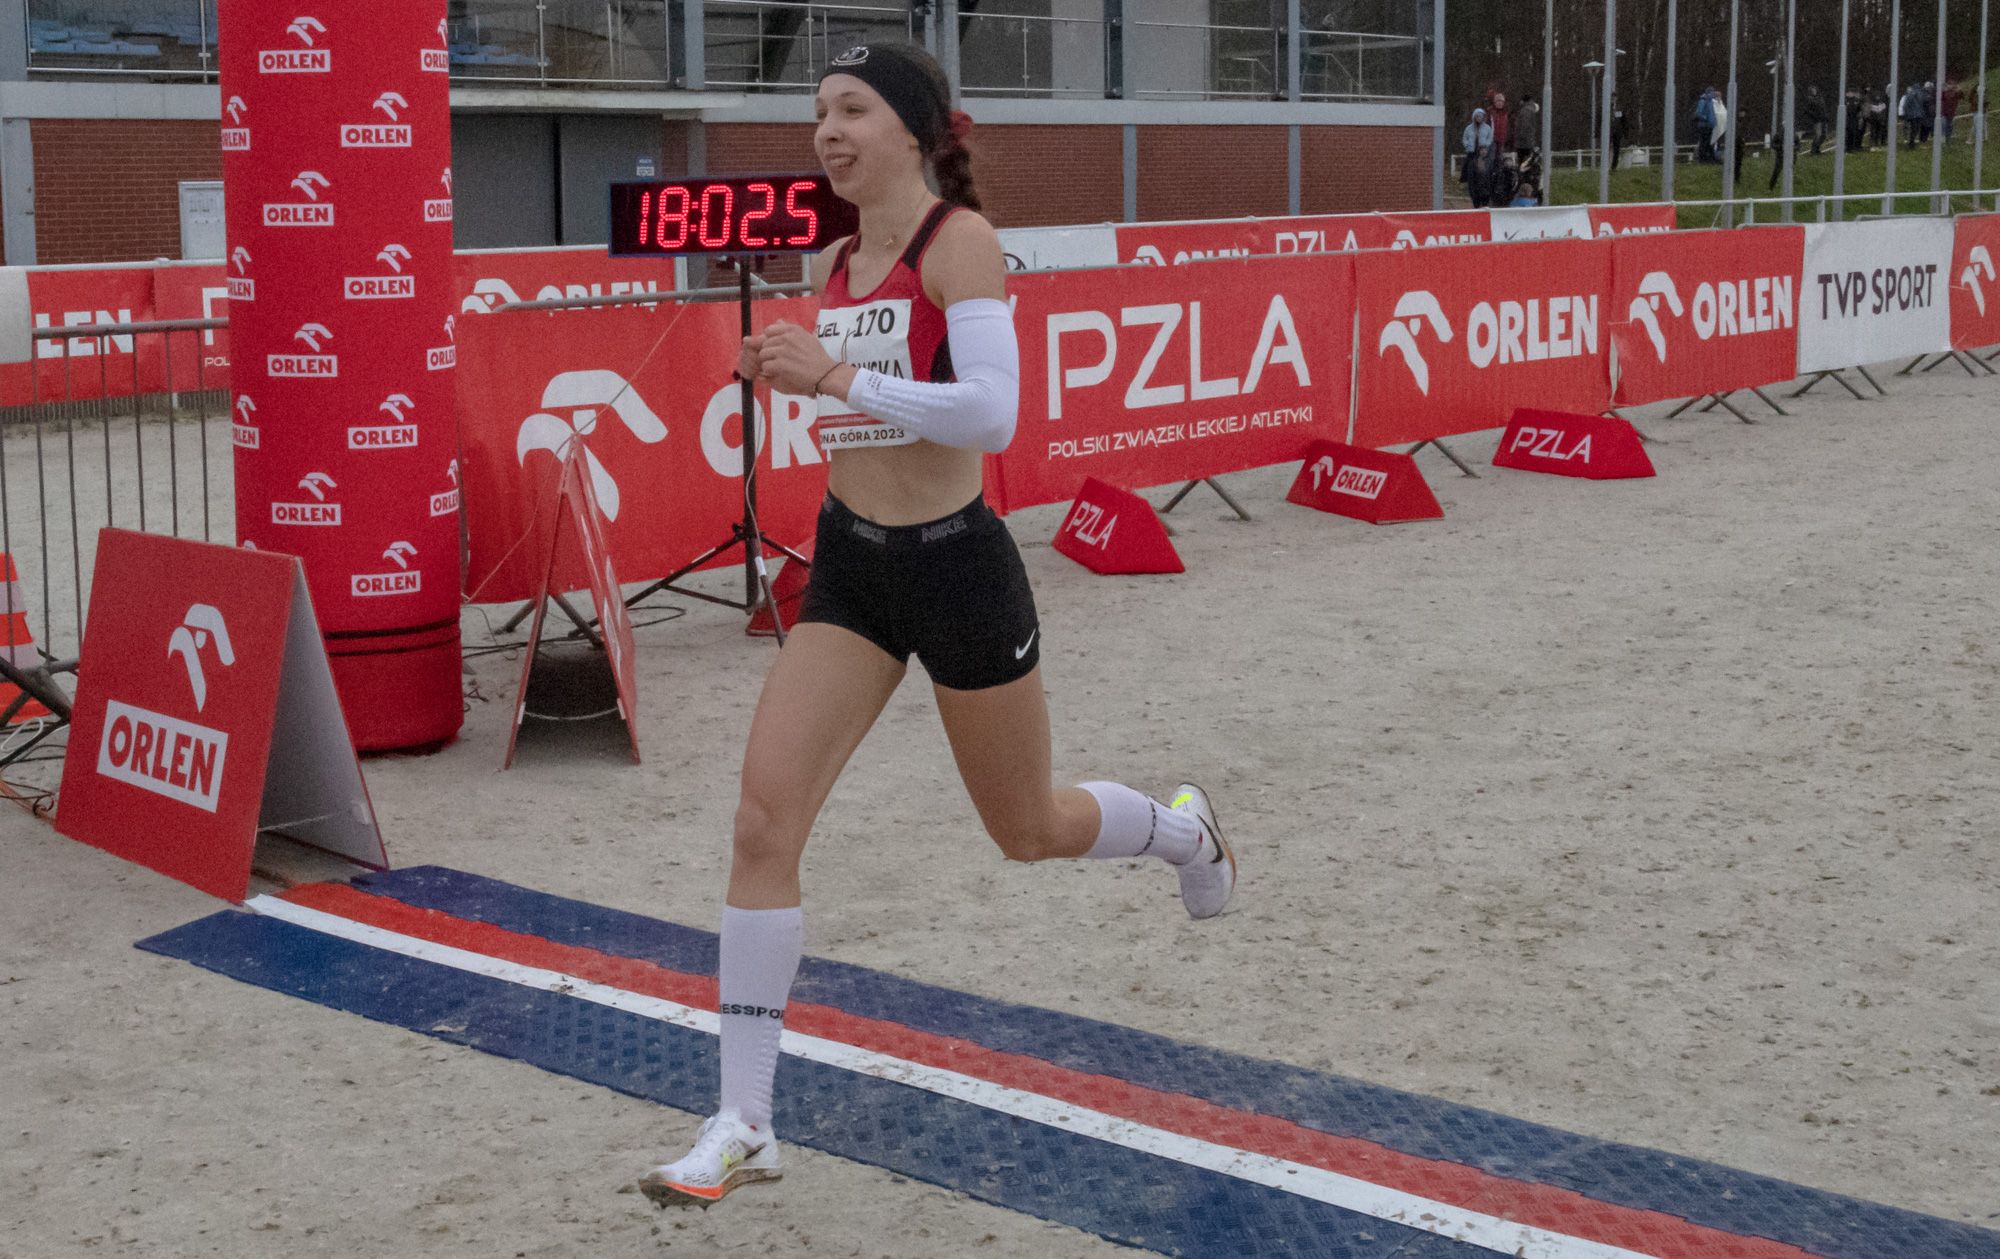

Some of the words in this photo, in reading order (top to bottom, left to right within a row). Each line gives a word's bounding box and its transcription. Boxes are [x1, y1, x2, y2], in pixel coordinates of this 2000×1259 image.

[262, 53, 326, 70] ORLEN
[423, 52, 448, 69] ORLE
[222, 131, 247, 147] RLEN
[345, 128, 408, 144] ORLEN
[266, 207, 329, 222] ORLEN
[427, 203, 453, 218] ORLE
[228, 281, 251, 297] RLEN
[349, 280, 411, 296] ORLEN
[1817, 271, 1867, 320] TVP
[1871, 264, 1937, 315] SPORT
[1692, 275, 1793, 340] ORLEN
[853, 307, 895, 338] 170
[35, 309, 133, 359] LEN
[1467, 295, 1599, 369] ORLEN
[204, 356, 230, 367] POL
[430, 351, 455, 367] ORLE
[1047, 294, 1312, 420] PZLA
[270, 359, 333, 374] ORLEN
[233, 428, 256, 445] RLEN
[352, 428, 414, 446] ORLEN
[700, 382, 832, 478] OR
[839, 429, 871, 443] GÓRA
[874, 428, 905, 440] 2023
[1048, 435, 1110, 460] POLSKI
[1113, 424, 1186, 450] ZWIĄZEK
[1189, 415, 1247, 439] LEKKIEJ
[1251, 406, 1313, 429] ATLETYKI
[1510, 426, 1592, 463] PZLA
[1336, 470, 1381, 495] ORLEN
[275, 506, 336, 522] ORLEN
[853, 519, 887, 544] NIKE
[921, 515, 967, 542] NIKE
[1065, 501, 1117, 550] PZLA
[356, 575, 417, 593] ORLEN
[108, 714, 217, 797] ORLEN
[720, 1003, 785, 1020] ESSPO
